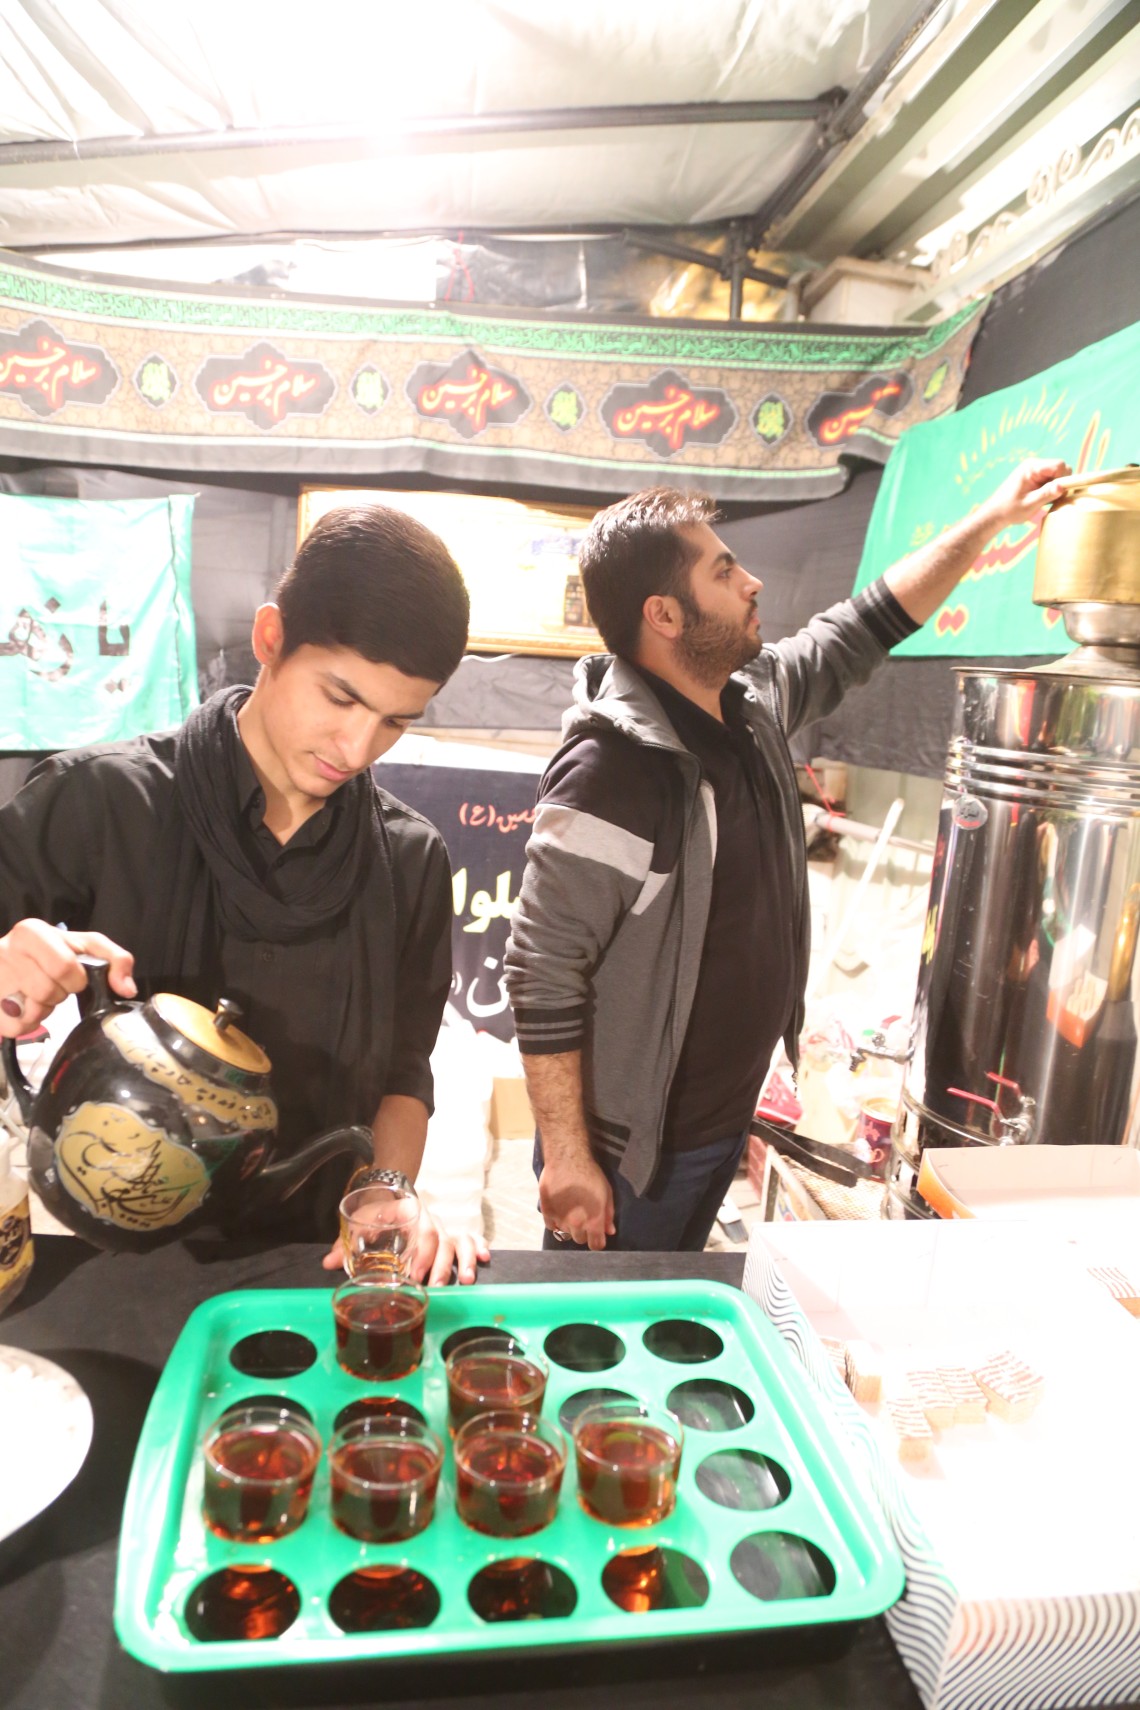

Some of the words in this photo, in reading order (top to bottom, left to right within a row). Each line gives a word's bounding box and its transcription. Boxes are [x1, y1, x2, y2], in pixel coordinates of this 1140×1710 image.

[33, 366, 51, 392] بر
[51, 358, 98, 404] سلام
[212, 359, 289, 406] حسین
[256, 383, 273, 407] بر
[273, 373, 317, 418] سلام
[421, 369, 489, 411] حسین
[461, 392, 477, 416] بر
[475, 382, 514, 425] سلام
[616, 388, 691, 433] حسین
[658, 411, 673, 434] بر
[673, 402, 718, 446] سلام
[0, 595, 74, 682] زه
[452, 867, 522, 933] لوا
